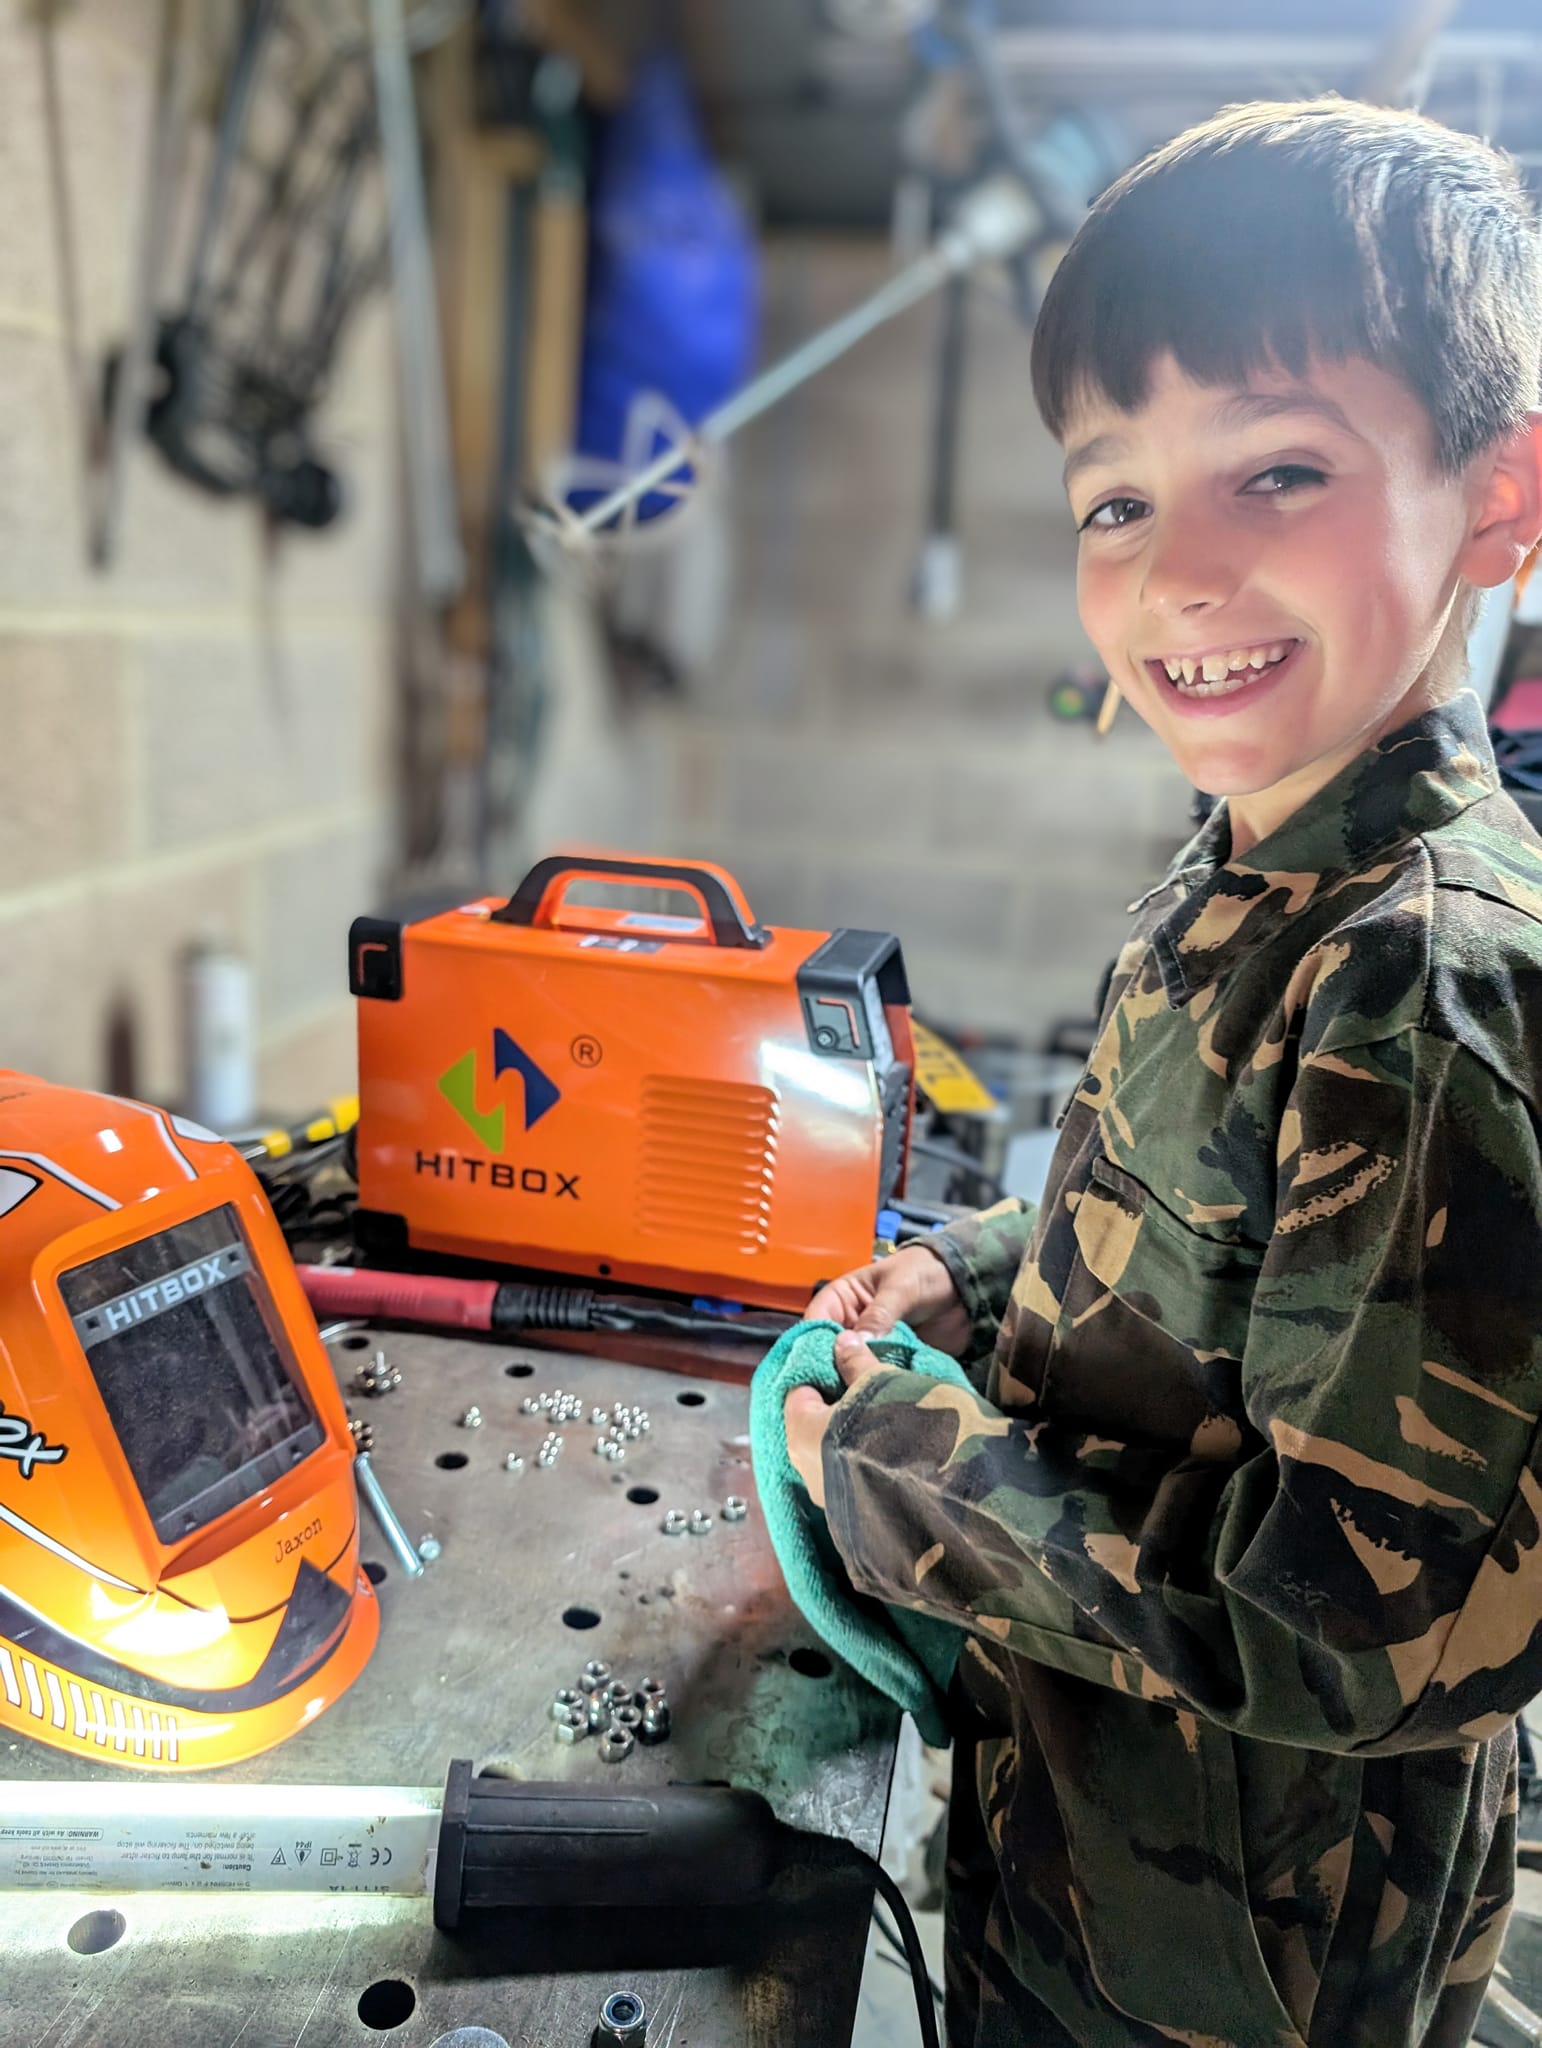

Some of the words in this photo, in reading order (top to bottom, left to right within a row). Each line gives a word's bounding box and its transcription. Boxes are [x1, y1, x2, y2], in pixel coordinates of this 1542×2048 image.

[416, 1151, 581, 1200] HITBOX
[106, 1257, 226, 1332] HITBOX
[274, 1517, 323, 1564] Jaxon
[219, 1832, 231, 1840] few
[295, 1840, 312, 1849] IP44
[172, 1851, 188, 1860] lamp
[202, 1853, 213, 1861] for
[370, 1848, 392, 1866] CE
